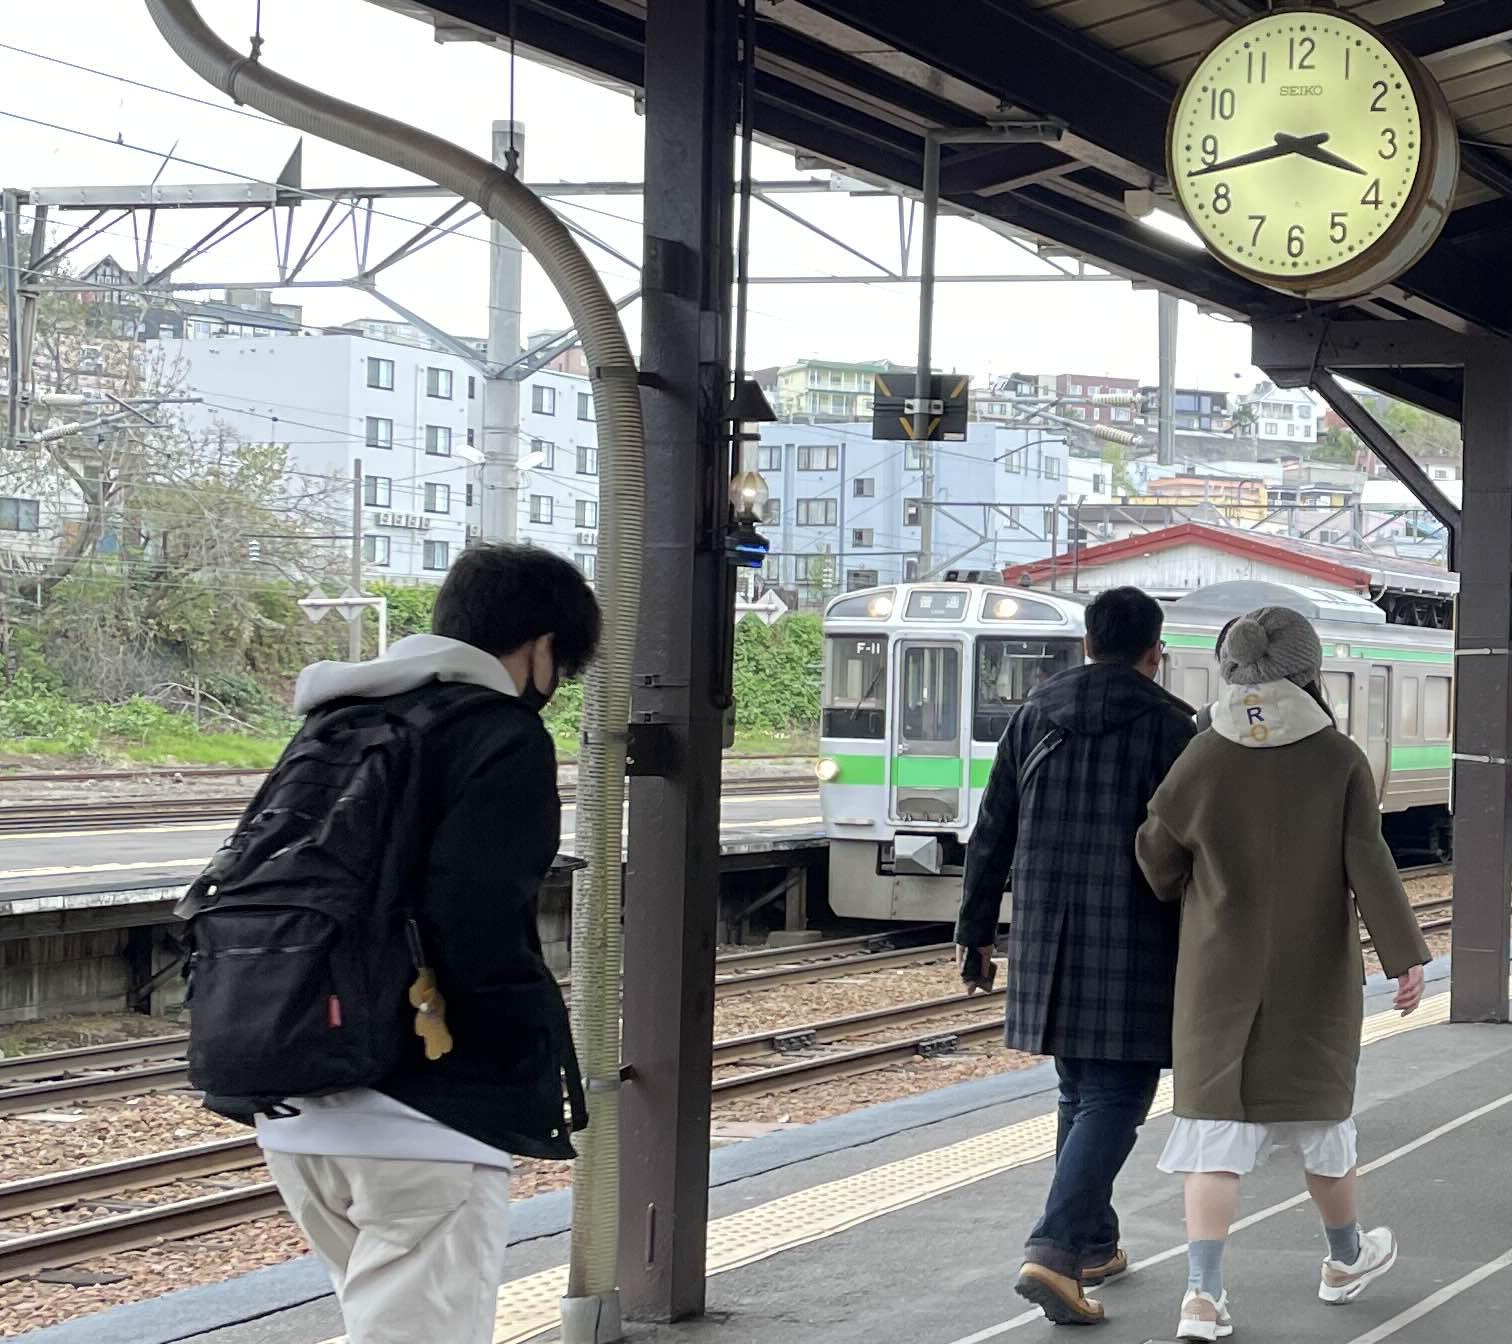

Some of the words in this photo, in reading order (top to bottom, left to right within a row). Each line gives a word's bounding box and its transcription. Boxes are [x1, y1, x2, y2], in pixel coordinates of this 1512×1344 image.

[1247, 51, 1267, 84] 11
[1289, 37, 1316, 70] 12
[1211, 87, 1236, 121] 10
[1279, 85, 1324, 97] SEIKO
[1370, 80, 1389, 113] 2
[1200, 134, 1219, 166] 9
[1377, 127, 1398, 160] 3
[1211, 182, 1232, 215] 8
[1360, 178, 1384, 211] 4
[1247, 215, 1267, 247] 7
[1286, 225, 1305, 258] 6
[1329, 212, 1349, 244] 5
